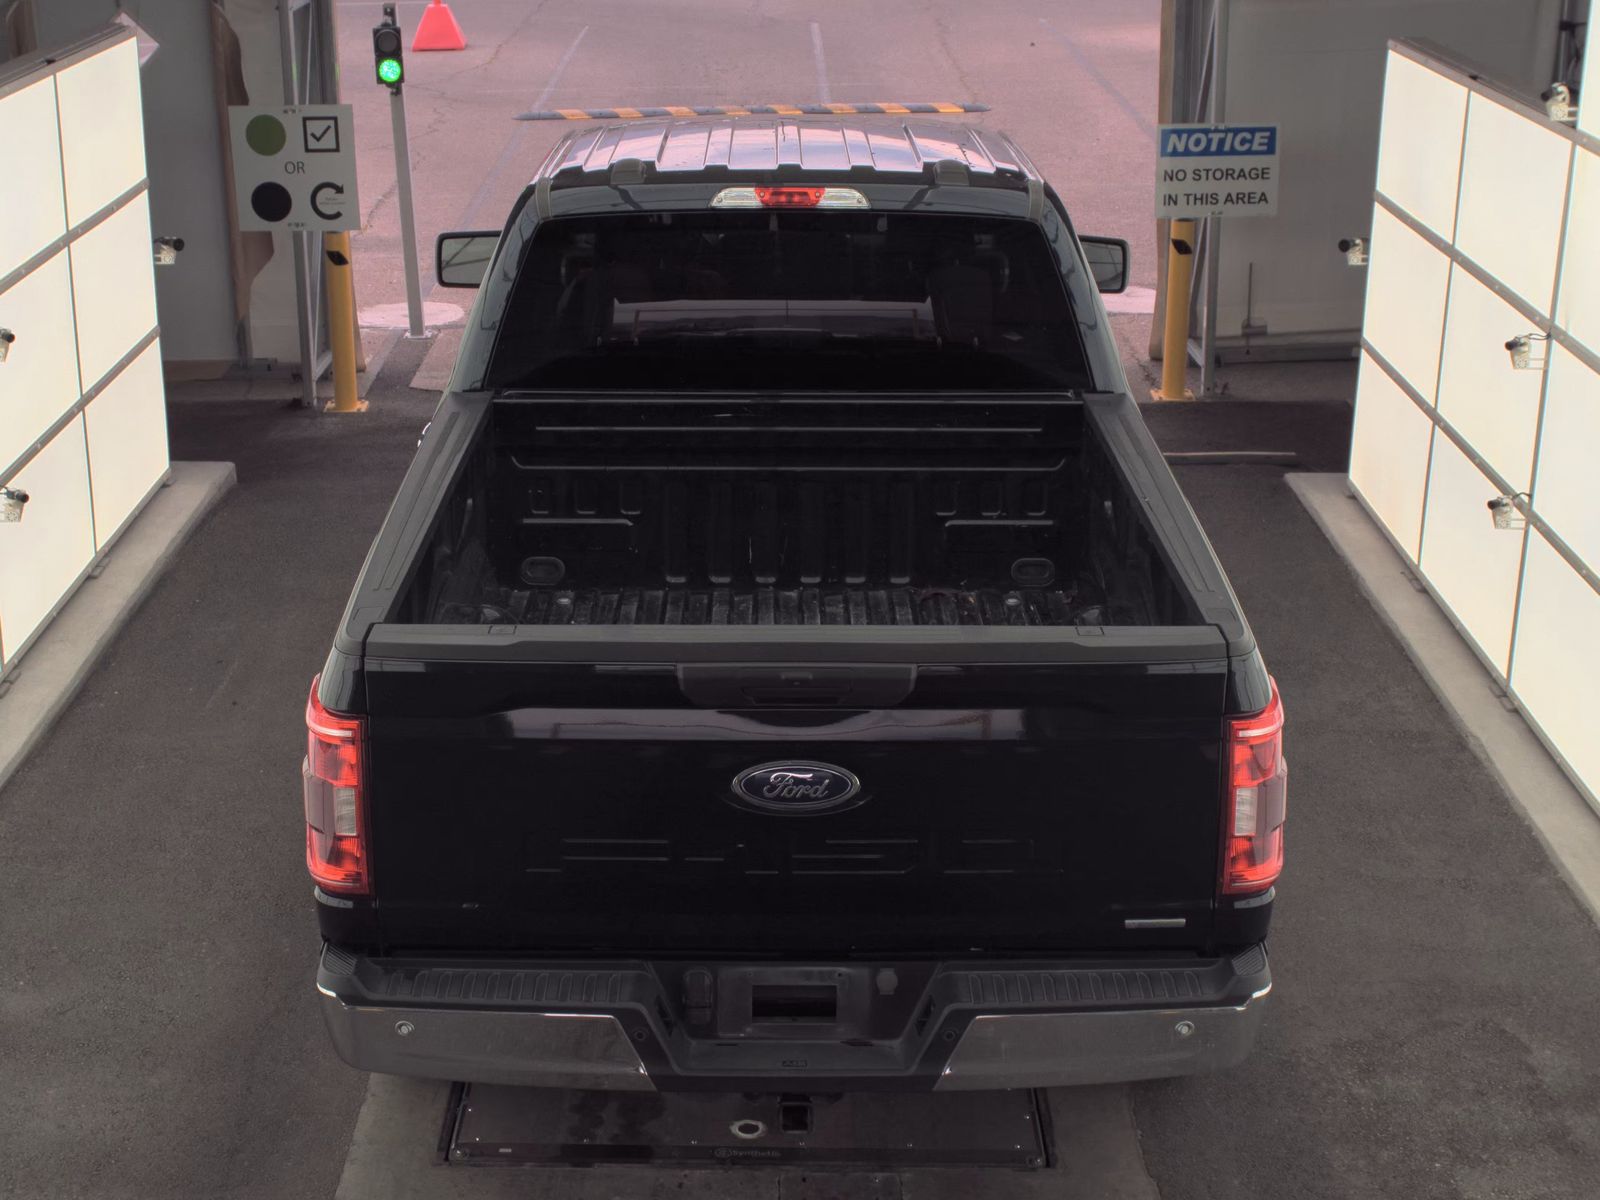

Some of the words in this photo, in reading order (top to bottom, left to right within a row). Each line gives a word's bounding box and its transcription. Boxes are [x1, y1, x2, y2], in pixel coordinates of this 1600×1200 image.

[1167, 131, 1271, 153] NOTICE
[284, 160, 306, 175] OR
[1163, 168, 1187, 182] NO
[1192, 166, 1271, 181] STORAGE
[1163, 193, 1178, 206] IN
[1184, 192, 1219, 206] THIS
[1223, 191, 1269, 205] AREA
[763, 771, 830, 799] Ford
